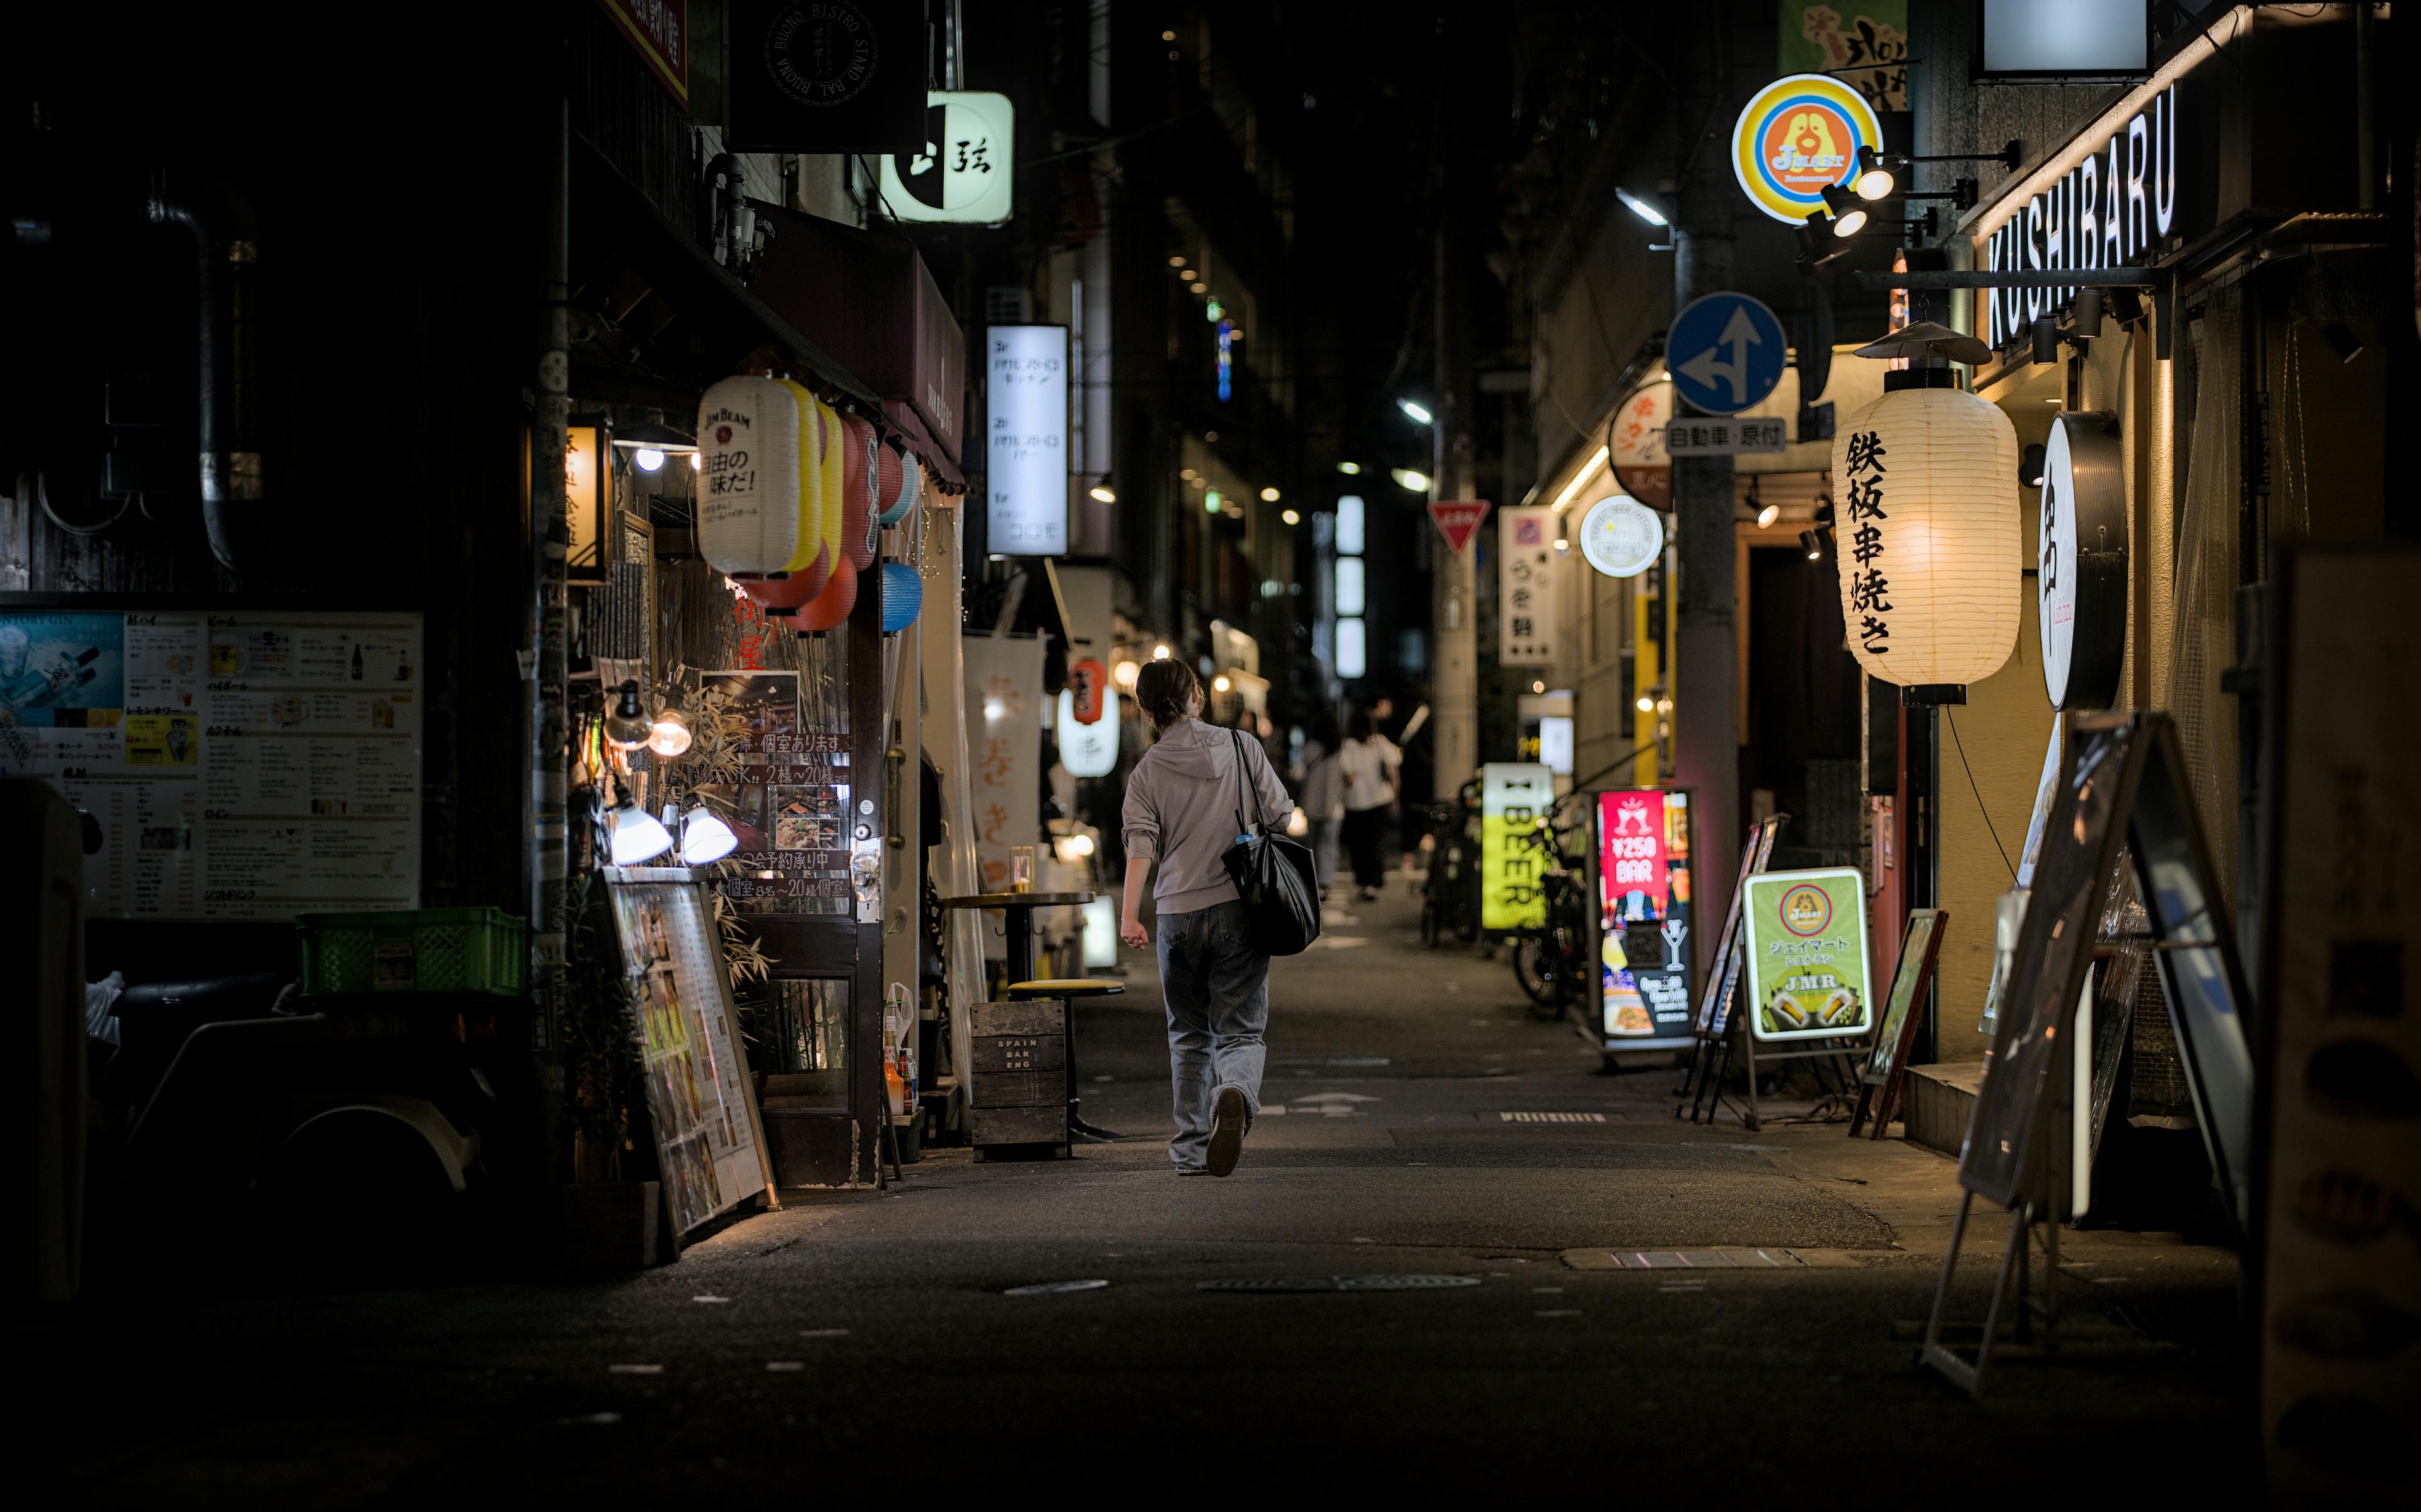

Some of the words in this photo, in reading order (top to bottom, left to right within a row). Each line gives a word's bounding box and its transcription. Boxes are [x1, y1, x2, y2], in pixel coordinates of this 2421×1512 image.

[811, 4, 861, 32] BISTRO
[775, 11, 804, 50] BUONO
[847, 38, 869, 81] STAND
[777, 57, 811, 94] BUONA
[819, 79, 846, 96] BAL
[1988, 82, 2176, 351] KUSHIBARU
[705, 413, 719, 430] JIM
[721, 408, 750, 430] BEAM
[1845, 430, 1894, 655] 鉄板串焼き
[49, 615, 73, 625] GIN
[207, 616, 236, 627] ビール
[1504, 806, 1533, 906] BEER
[1611, 836, 1658, 858] ¥250
[1615, 859, 1654, 884] BAR
[1769, 937, 1850, 956] ジェイマート
[1785, 953, 1835, 968] レストラン
[1784, 974, 1839, 992] JMR
[998, 1039, 1037, 1047] SPAIN
[1007, 1051, 1030, 1059] BAR
[1007, 1061, 1030, 1069] ENG
